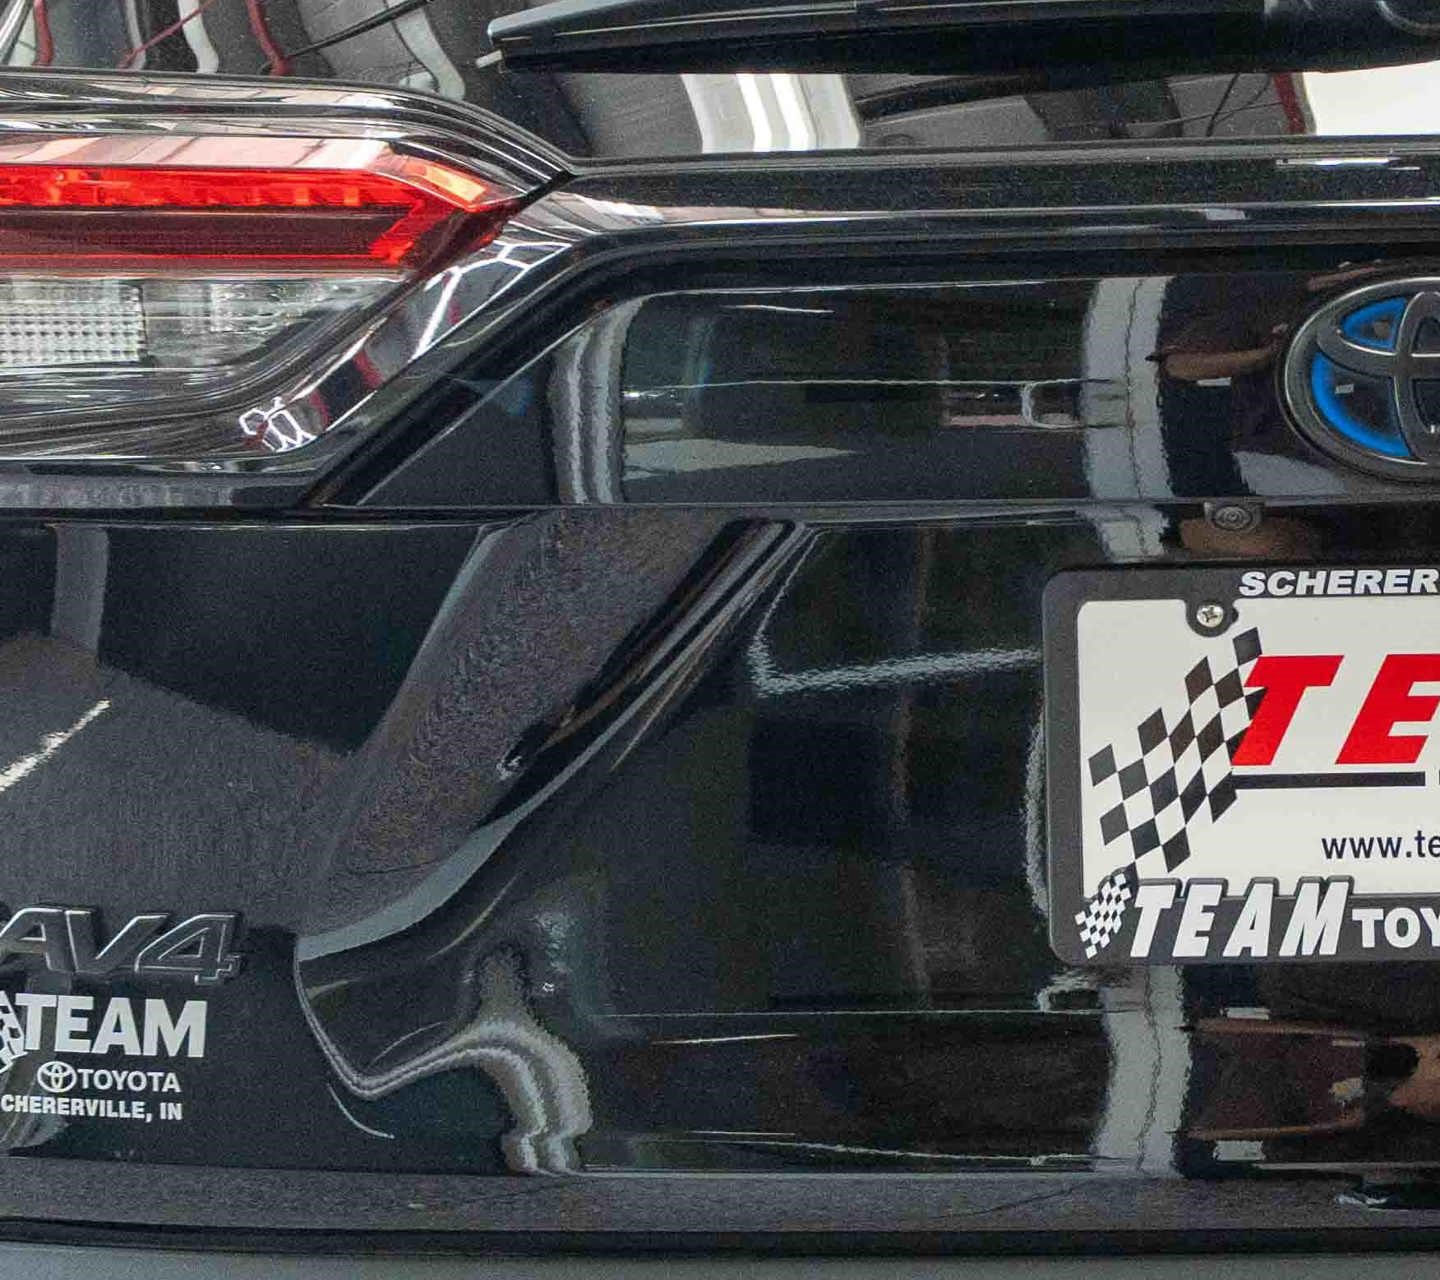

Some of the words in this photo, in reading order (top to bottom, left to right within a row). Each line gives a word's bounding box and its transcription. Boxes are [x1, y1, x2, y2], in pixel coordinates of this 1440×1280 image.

[1129, 882, 1349, 957] TEAM
[15, 993, 208, 1058] TEAM
[77, 1069, 182, 1093] TOYOTA
[159, 1102, 183, 1120] IN
